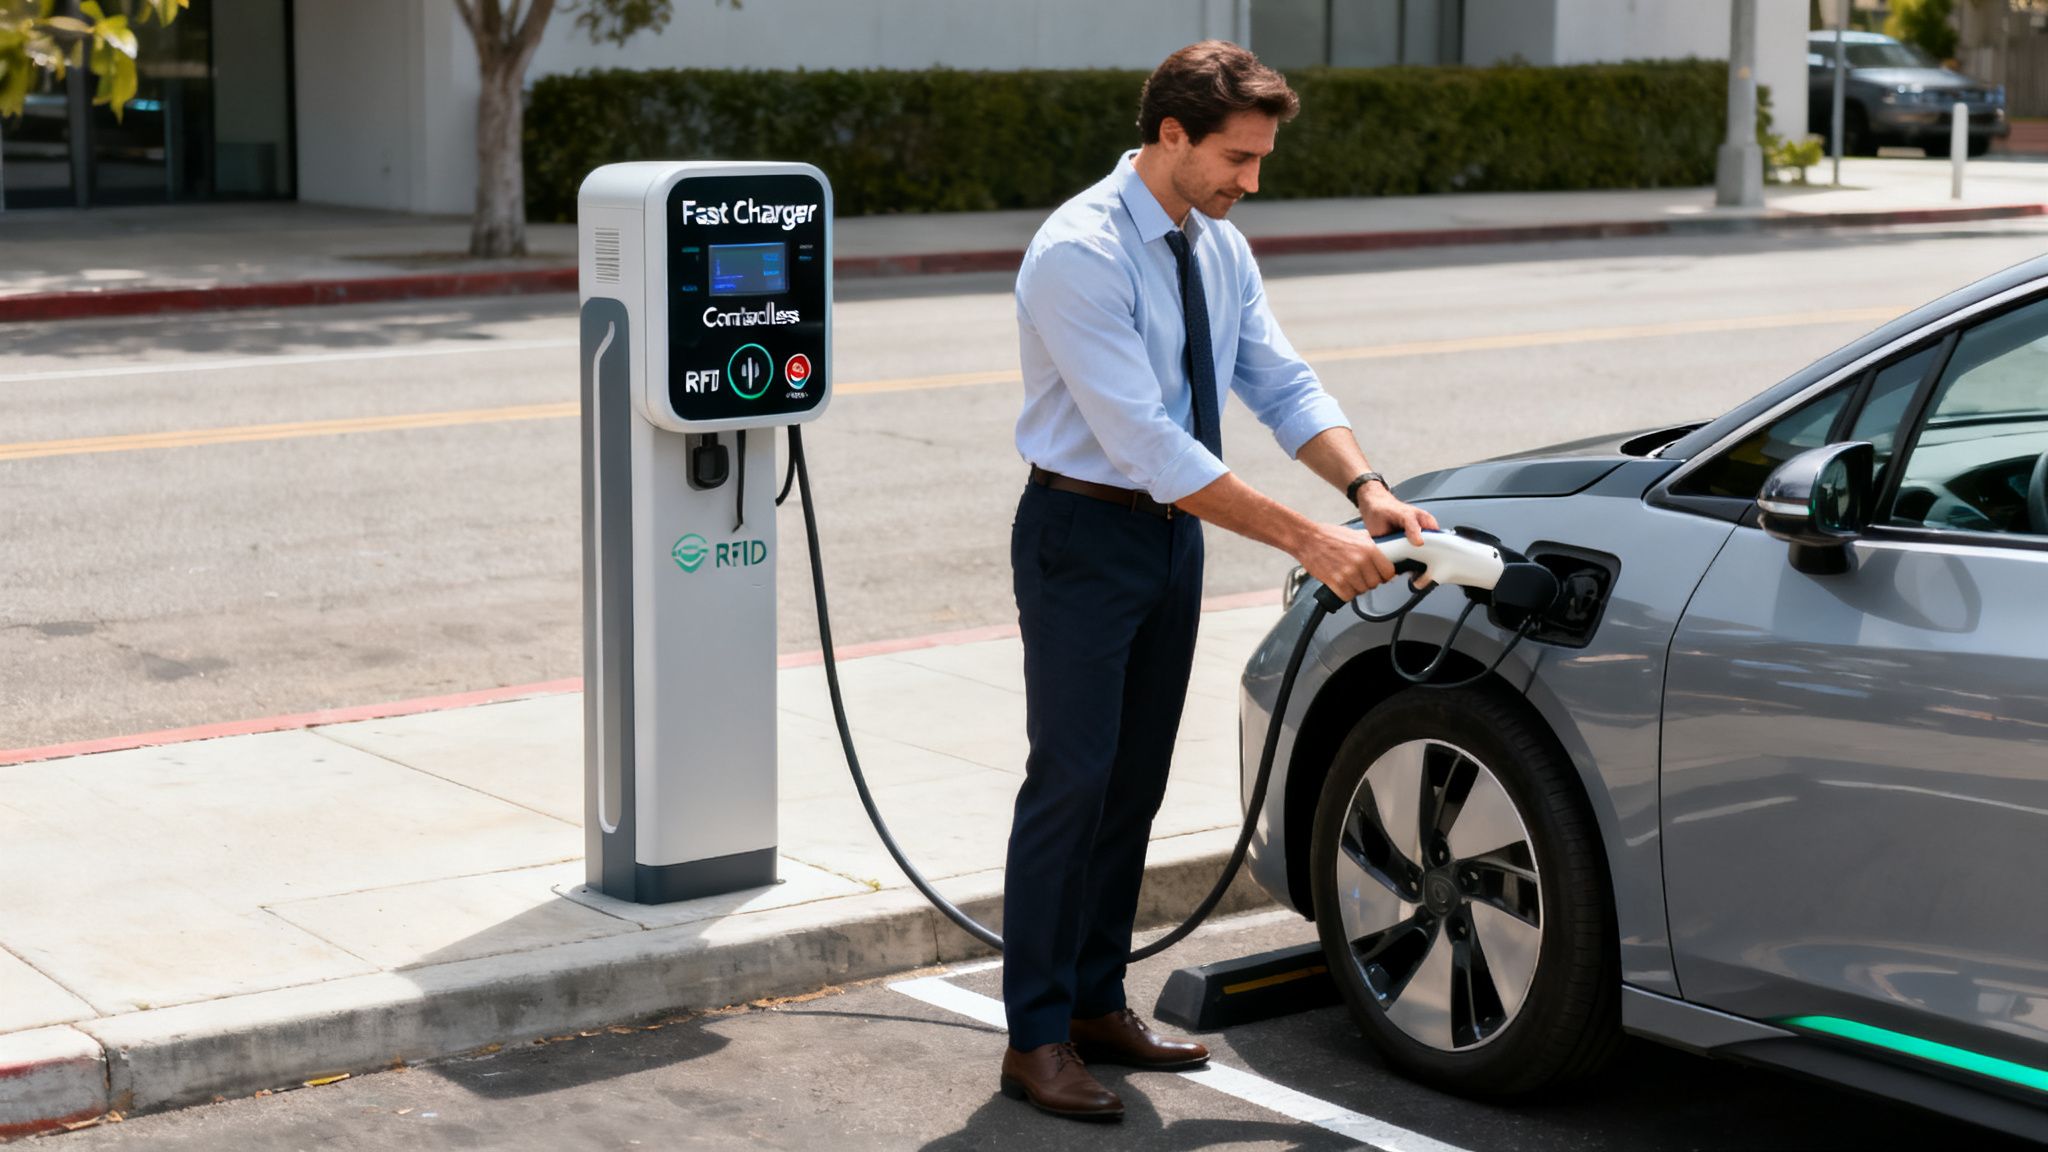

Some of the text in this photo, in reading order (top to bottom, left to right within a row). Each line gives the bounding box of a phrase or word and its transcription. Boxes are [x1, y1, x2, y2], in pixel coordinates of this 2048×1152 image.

[682, 198, 817, 231] Fast Charger
[716, 540, 767, 568] RFID
